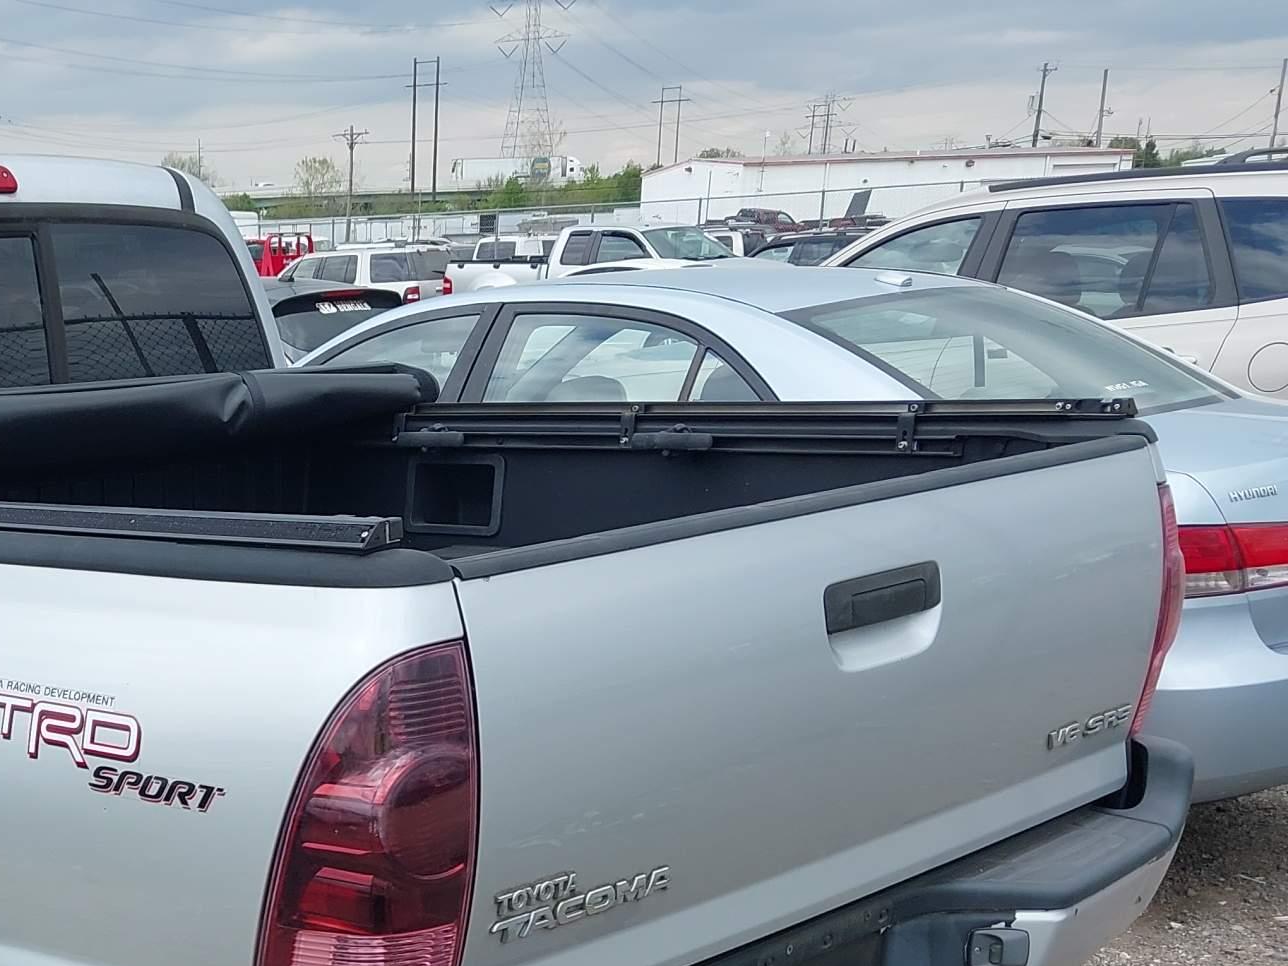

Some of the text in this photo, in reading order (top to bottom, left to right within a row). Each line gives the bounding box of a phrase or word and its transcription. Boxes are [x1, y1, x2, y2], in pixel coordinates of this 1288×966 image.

[1228, 485, 1278, 503] HYUNDAI
[6, 680, 41, 695] RACING
[43, 686, 116, 707] DEVELOPMENT
[88, 765, 226, 813] SPORT
[489, 865, 671, 944] TACOMA
[495, 871, 577, 918] TOYOTA
